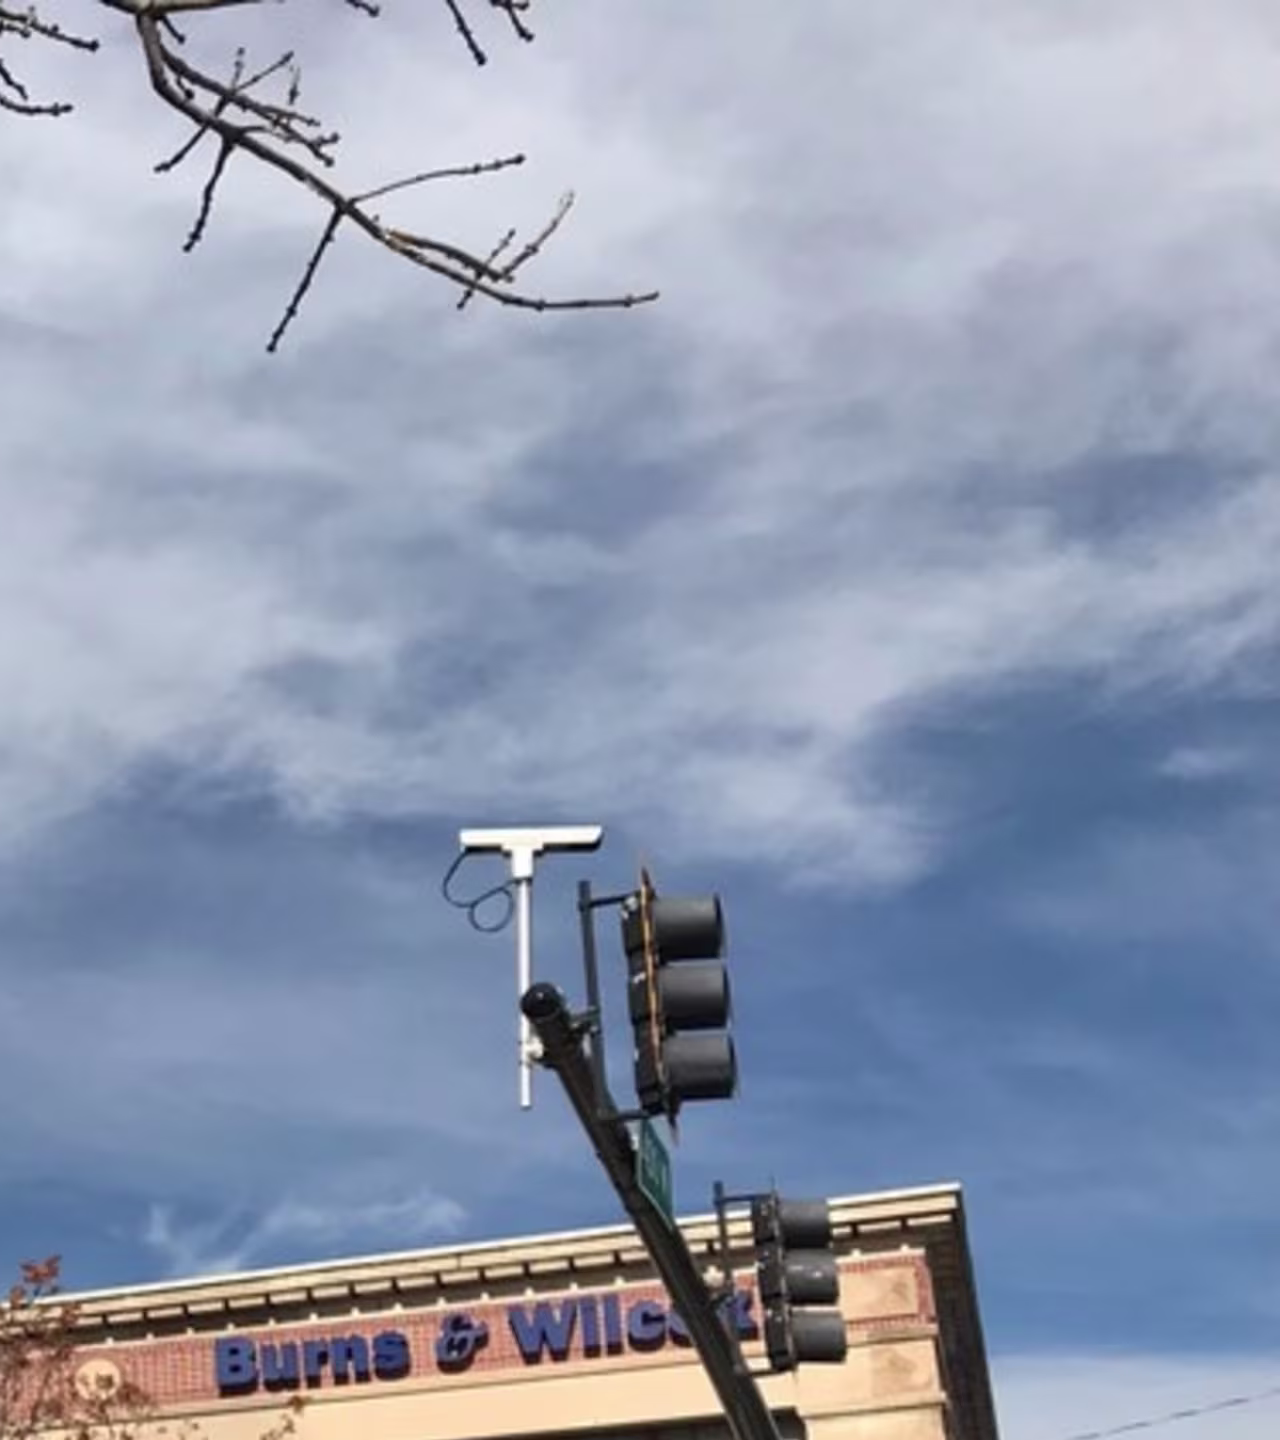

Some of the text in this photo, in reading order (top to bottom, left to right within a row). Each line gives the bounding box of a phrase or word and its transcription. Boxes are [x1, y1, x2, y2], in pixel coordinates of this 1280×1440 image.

[214, 1289, 759, 1396] Burns & Wilcx
